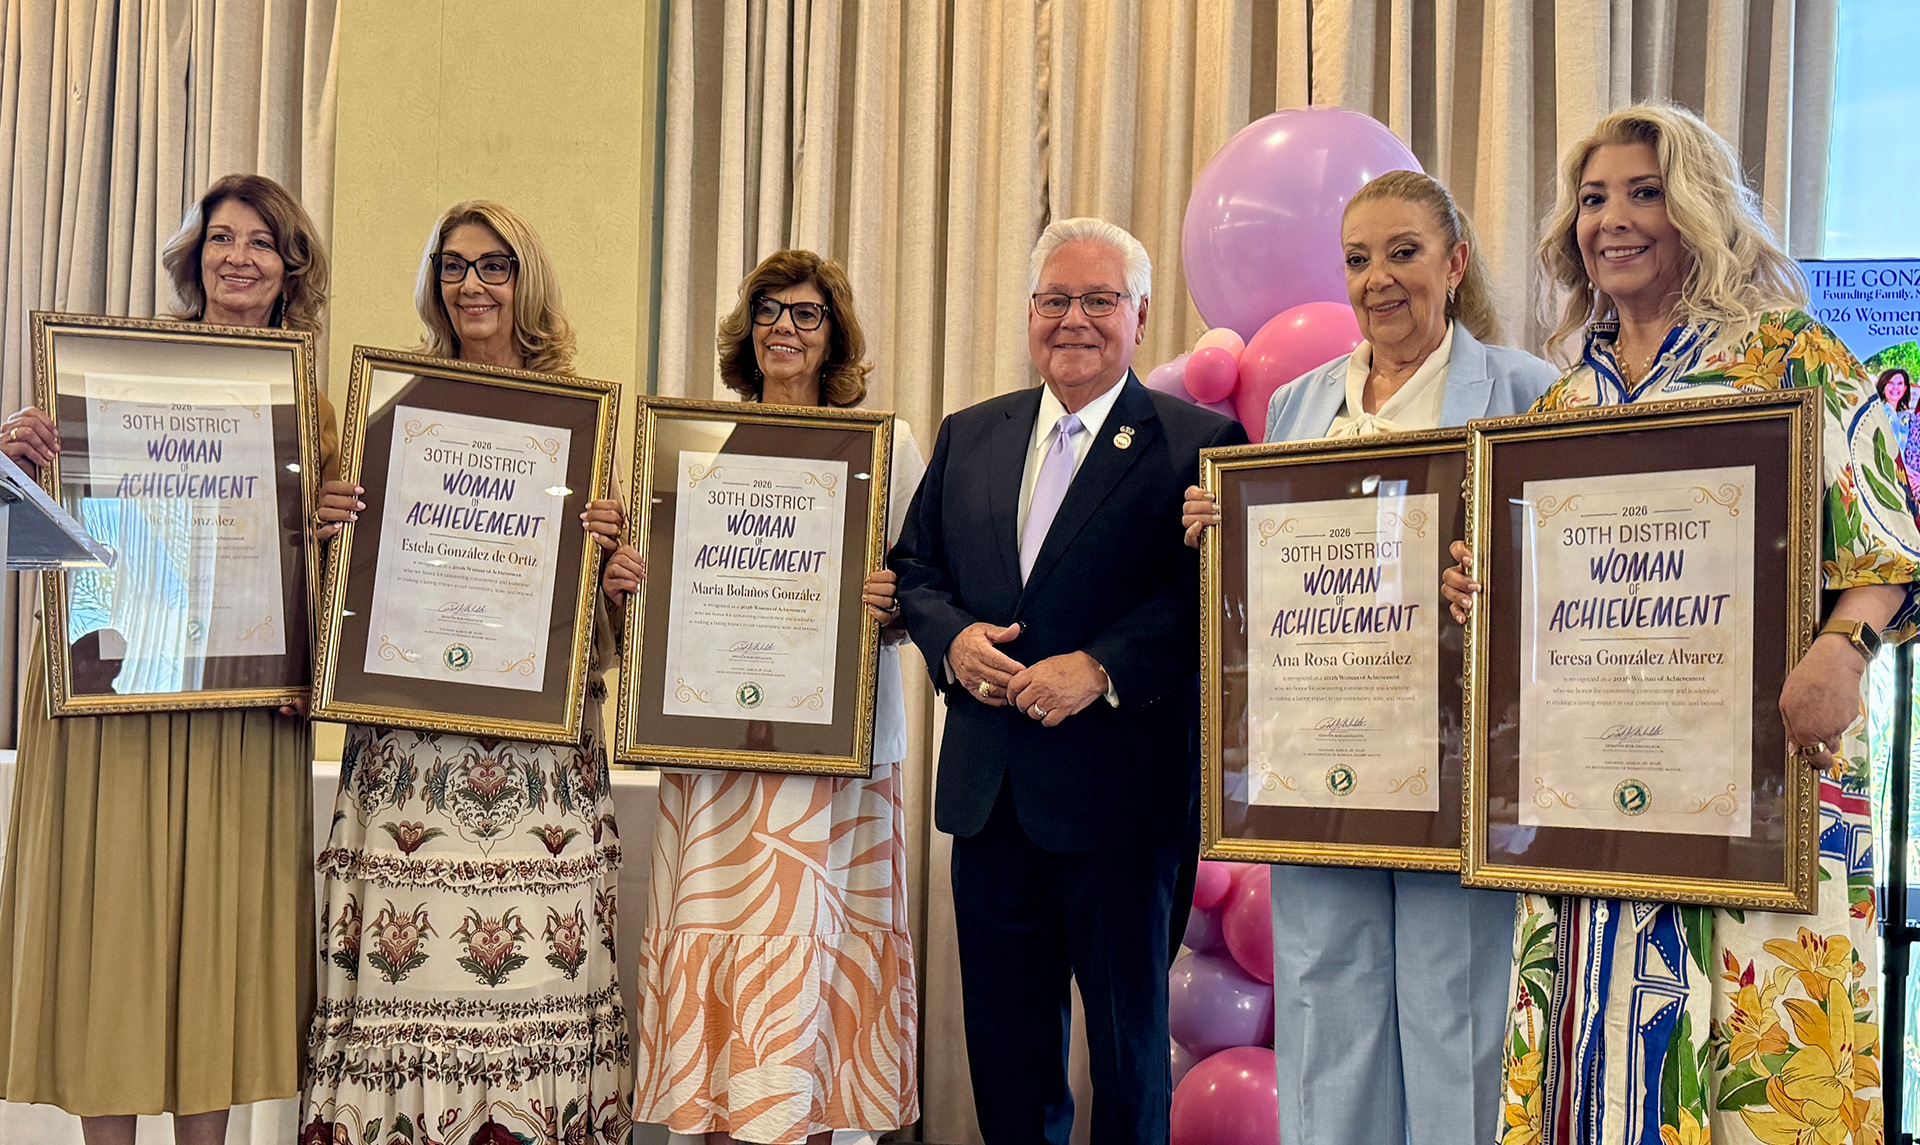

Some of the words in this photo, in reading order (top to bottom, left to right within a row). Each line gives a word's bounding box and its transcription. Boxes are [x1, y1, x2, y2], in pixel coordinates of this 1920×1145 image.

[1812, 270, 1855, 287] THE
[1823, 289, 1873, 301] Founding
[1876, 288, 1913, 300] Family,
[1855, 308, 1920, 322] Women
[1868, 324, 1918, 336] Senate
[123, 414, 164, 430] 30TH
[170, 416, 240, 434] DISTRICT
[148, 434, 222, 464] WOMAN
[472, 441, 492, 450] 2026
[180, 463, 189, 472] OF
[424, 448, 463, 466] 30TH
[468, 454, 536, 475] DISTRICT
[116, 472, 258, 499] ACHIEVEMENT
[443, 468, 515, 502] WOMAN
[753, 480, 772, 488] 2026
[471, 498, 480, 507] OF
[708, 491, 745, 506] 30TH
[750, 493, 816, 511] DISTRICT
[406, 502, 545, 538] ACHIEVEMENT
[1622, 506, 1648, 517] 2026
[727, 509, 796, 539] WOMAN
[1330, 528, 1351, 538] 2026
[1563, 526, 1612, 546] 30TH
[1620, 520, 1710, 544] DISTRICT
[755, 537, 763, 546] OF
[402, 538, 434, 554] Estela
[438, 543, 489, 561] González
[492, 550, 505, 563] de
[509, 553, 538, 567] Ortiz
[694, 544, 826, 573] ACHIEVEMENT
[1281, 545, 1321, 563] 30TH
[1328, 541, 1402, 560] DISTRICT
[1590, 548, 1684, 584] WOMAN
[1304, 564, 1381, 596] WOMAN
[1629, 583, 1640, 595] OF
[727, 584, 769, 598] Bolaños
[772, 587, 821, 601] González
[1336, 595, 1345, 606] OF
[1271, 604, 1419, 638] ACHIEVEMENT
[1549, 594, 1730, 633] ACHIEVEMENT
[1272, 653, 1299, 667] Ana
[1305, 652, 1337, 666] Rosa
[1342, 651, 1412, 665] González
[1548, 650, 1592, 666] Teresa
[1596, 649, 1665, 666] González
[1668, 648, 1724, 665] Alvarez
